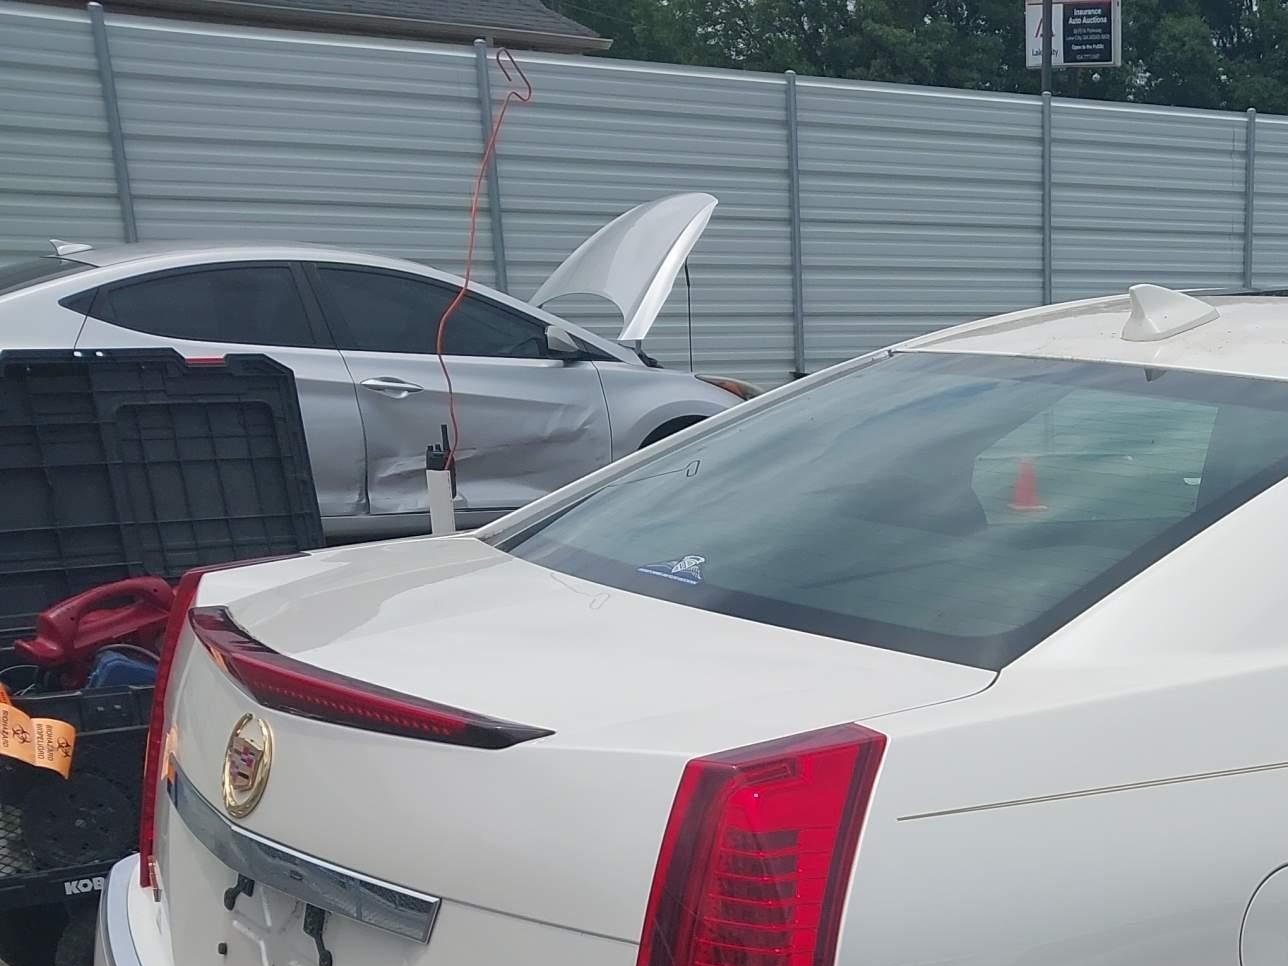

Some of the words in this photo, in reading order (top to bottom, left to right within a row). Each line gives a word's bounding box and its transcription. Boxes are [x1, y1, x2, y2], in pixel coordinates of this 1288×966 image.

[1068, 16, 1081, 24] Auto
[1082, 16, 1108, 24] Auctions
[64, 876, 105, 895] KOB
